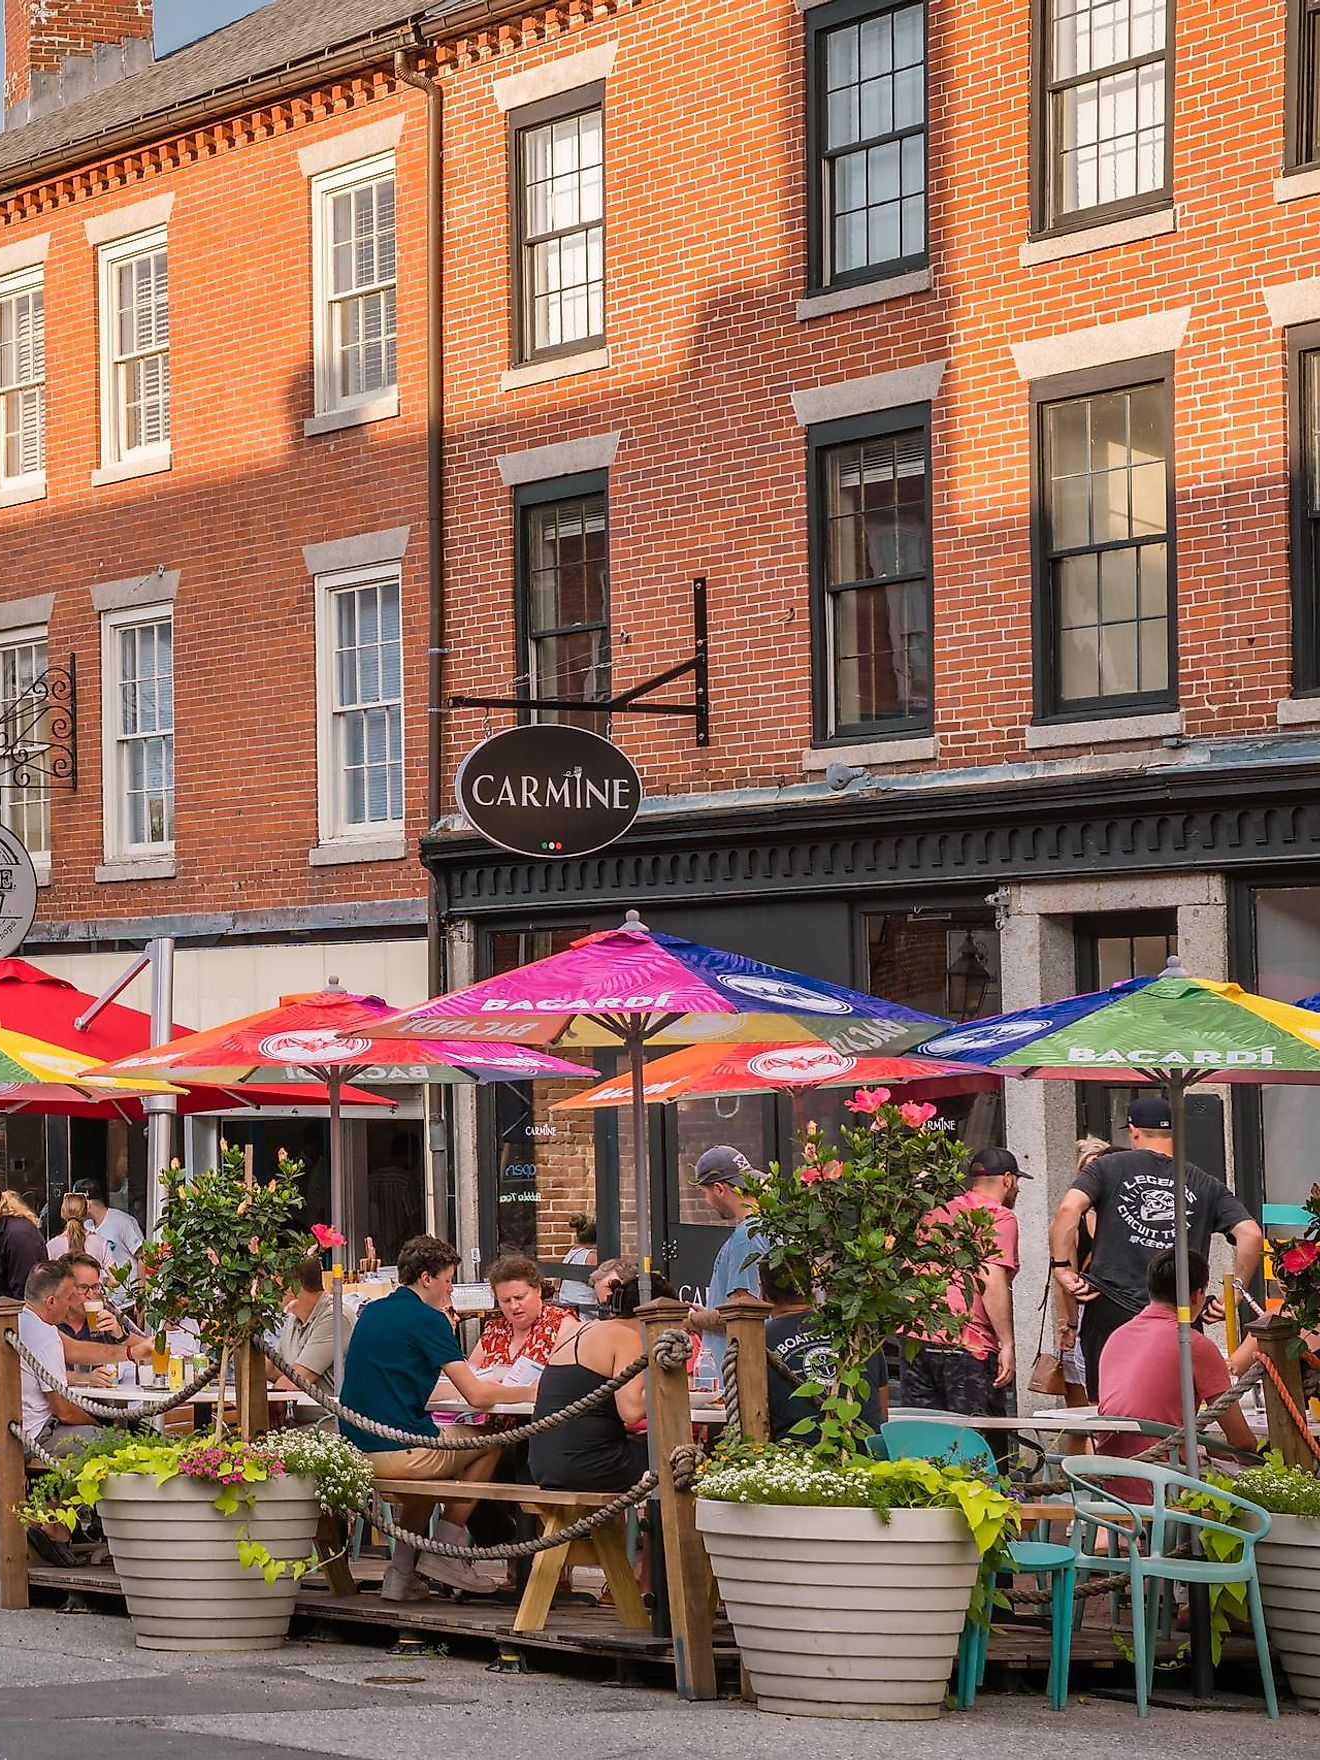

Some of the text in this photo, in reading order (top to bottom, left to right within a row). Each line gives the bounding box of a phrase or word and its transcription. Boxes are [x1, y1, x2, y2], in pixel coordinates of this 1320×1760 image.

[471, 770, 630, 809] CARMINE
[524, 1123, 558, 1137] CARMINE
[921, 1117, 957, 1131] ARMINE
[1123, 1174, 1199, 1204] LEGES
[1117, 1204, 1160, 1240] CIRCUIT
